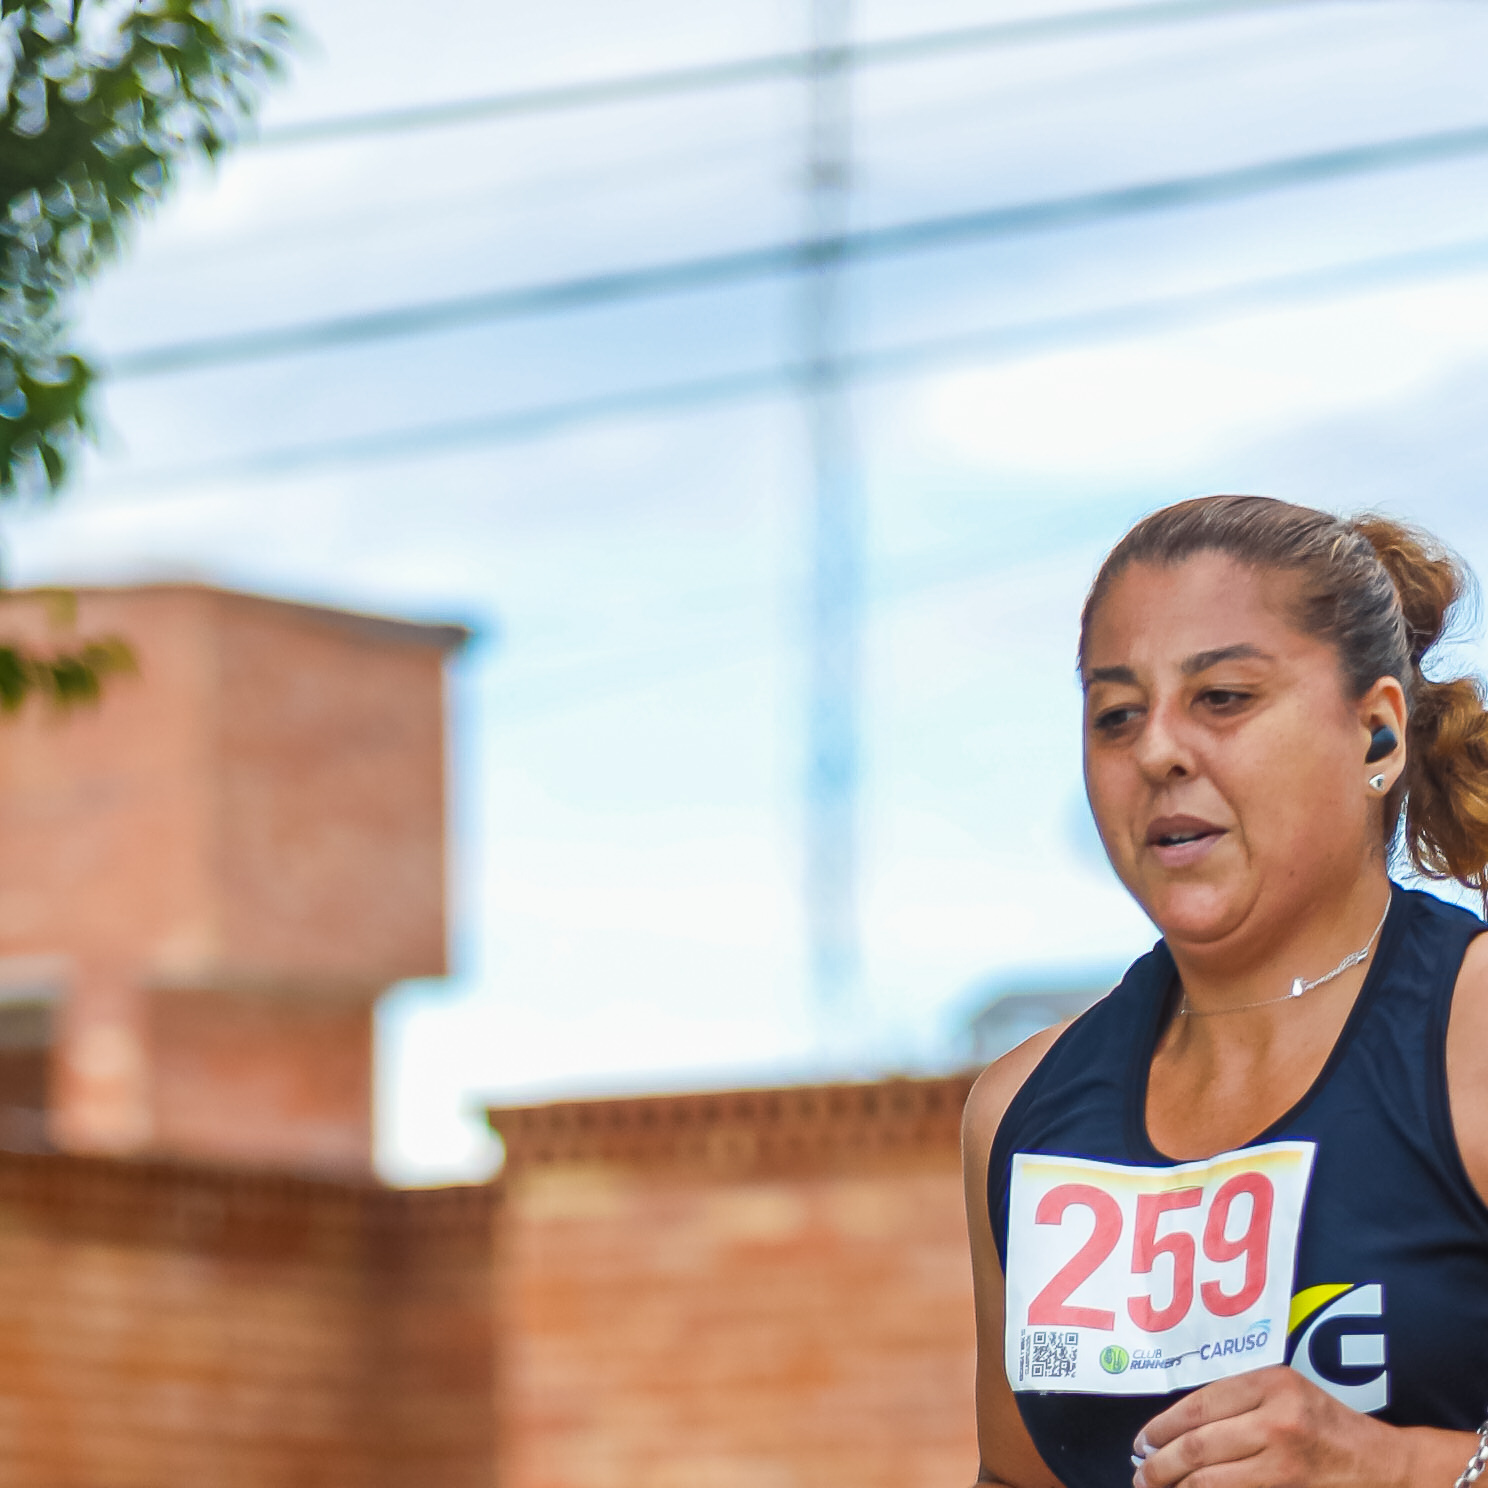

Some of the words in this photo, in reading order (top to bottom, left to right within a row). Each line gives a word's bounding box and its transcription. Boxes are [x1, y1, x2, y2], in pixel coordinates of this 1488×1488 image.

[1027, 1171, 1275, 1333] 259
[1132, 1348, 1162, 1359] CLUB
[1200, 1331, 1268, 1361] CARUSO
